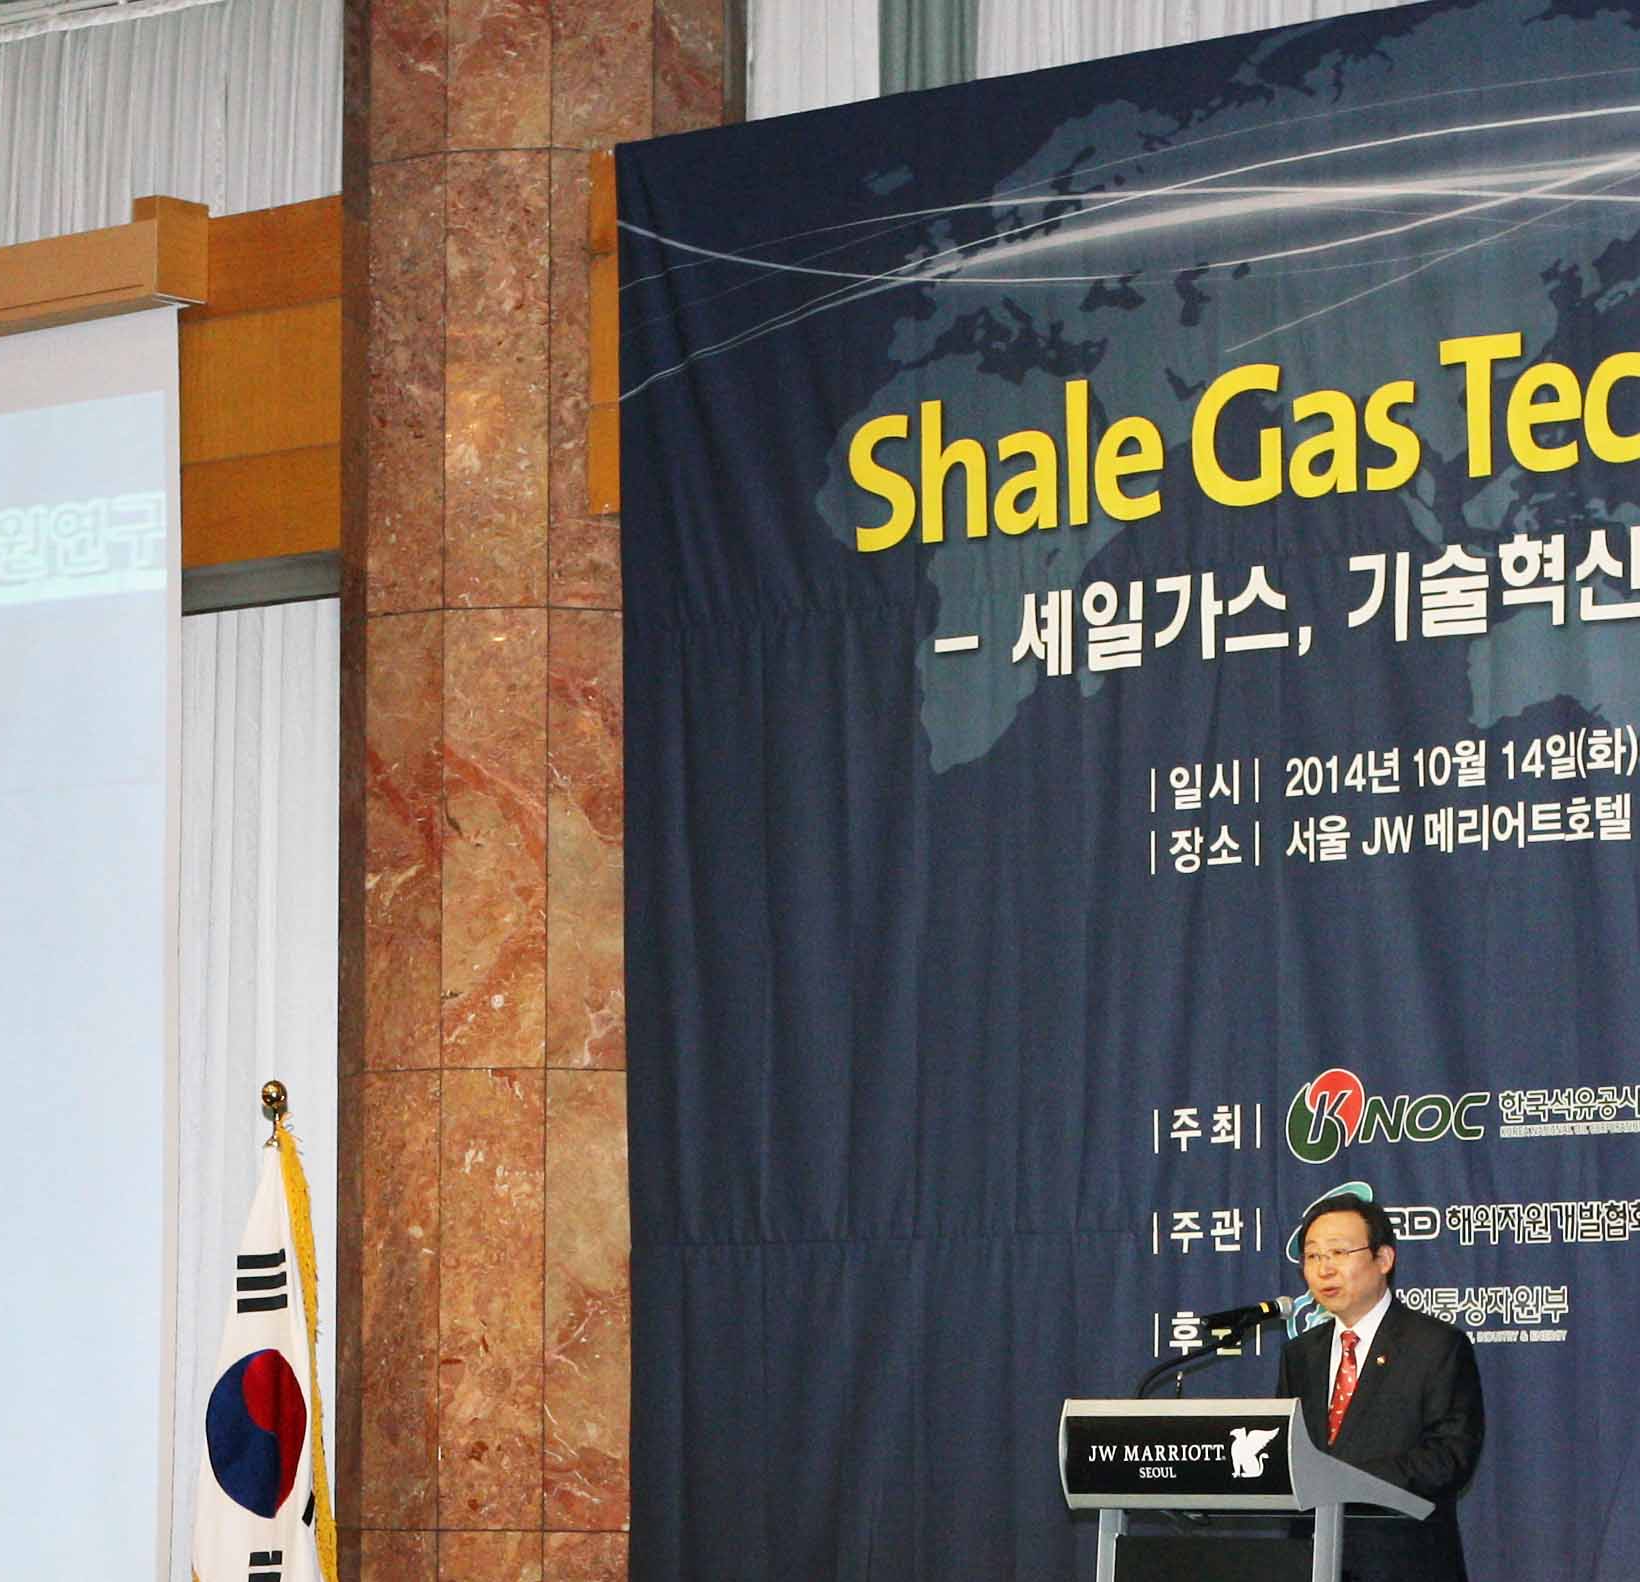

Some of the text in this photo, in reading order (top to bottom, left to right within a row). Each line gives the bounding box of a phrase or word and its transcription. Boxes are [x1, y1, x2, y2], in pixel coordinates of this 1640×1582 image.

[848, 378, 1165, 553] Shale
[1191, 363, 1421, 508] Gas
[1012, 565, 1312, 677] 셰일가스,
[1285, 747, 1400, 797] 2014년
[1413, 739, 1487, 788] 10월
[1501, 724, 1638, 780] 14일(화)
[1285, 815, 1351, 863] 서울
[1361, 814, 1414, 856] JW
[1424, 792, 1632, 853] 메리어트호텔
[1170, 1104, 1241, 1152] 주최
[1170, 1208, 1243, 1254] 주관
[1382, 1206, 1441, 1241] RD
[1088, 1444, 1225, 1463] JW MARRIOTT
[1139, 1466, 1177, 1479] SEOUL
